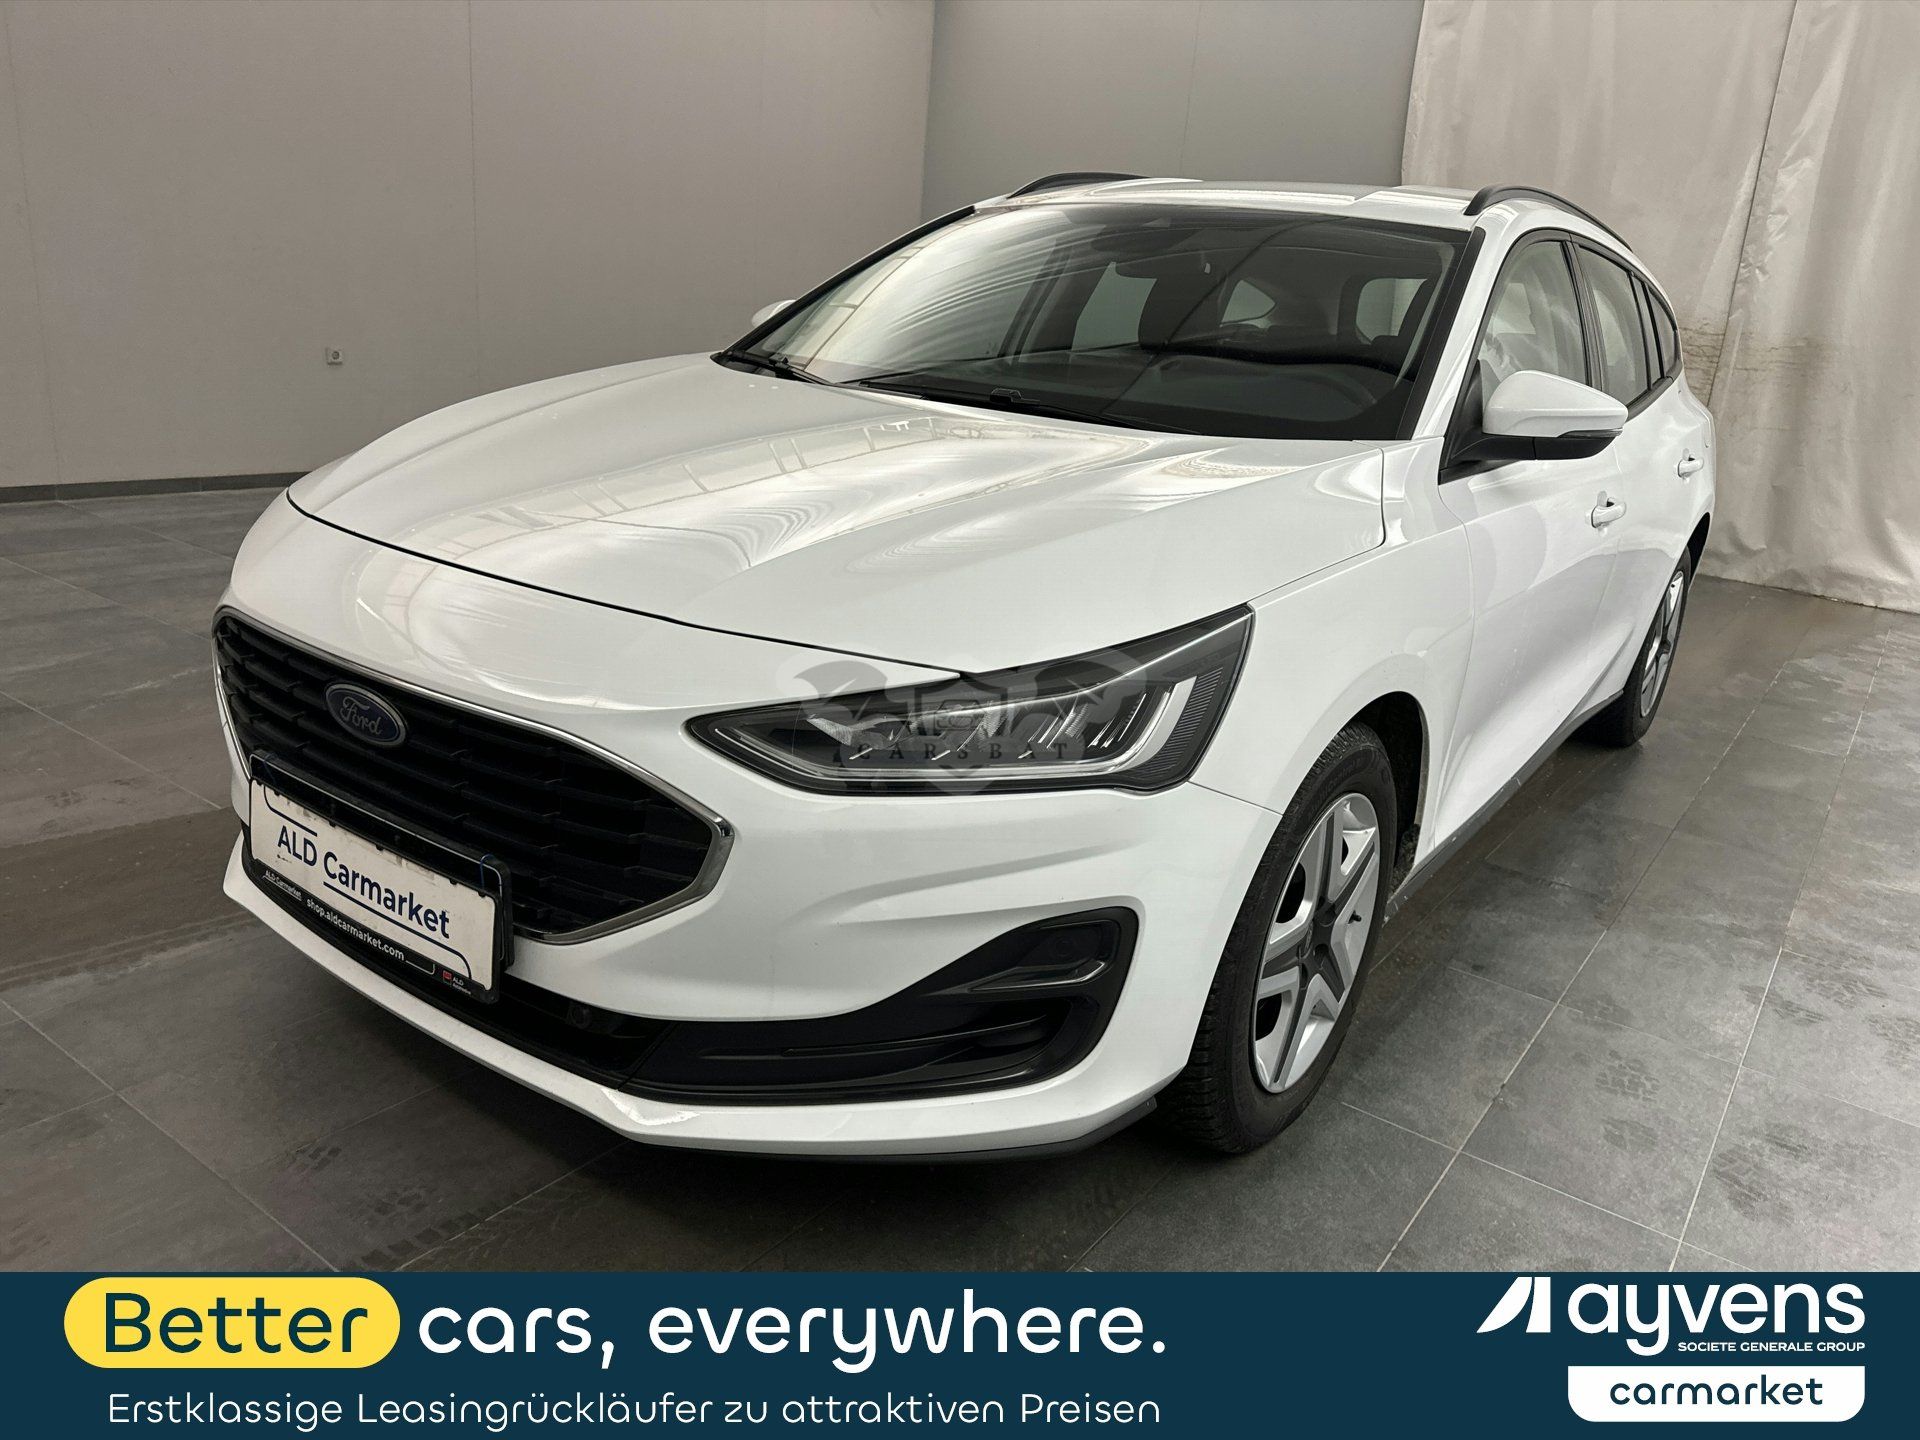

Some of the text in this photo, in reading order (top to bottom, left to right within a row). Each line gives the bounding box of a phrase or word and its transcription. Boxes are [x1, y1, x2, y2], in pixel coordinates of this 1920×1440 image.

[340, 696, 383, 735] Ford
[277, 825, 450, 939] ALD Carmarket
[306, 898, 405, 961] shop.aldcarmarket.com
